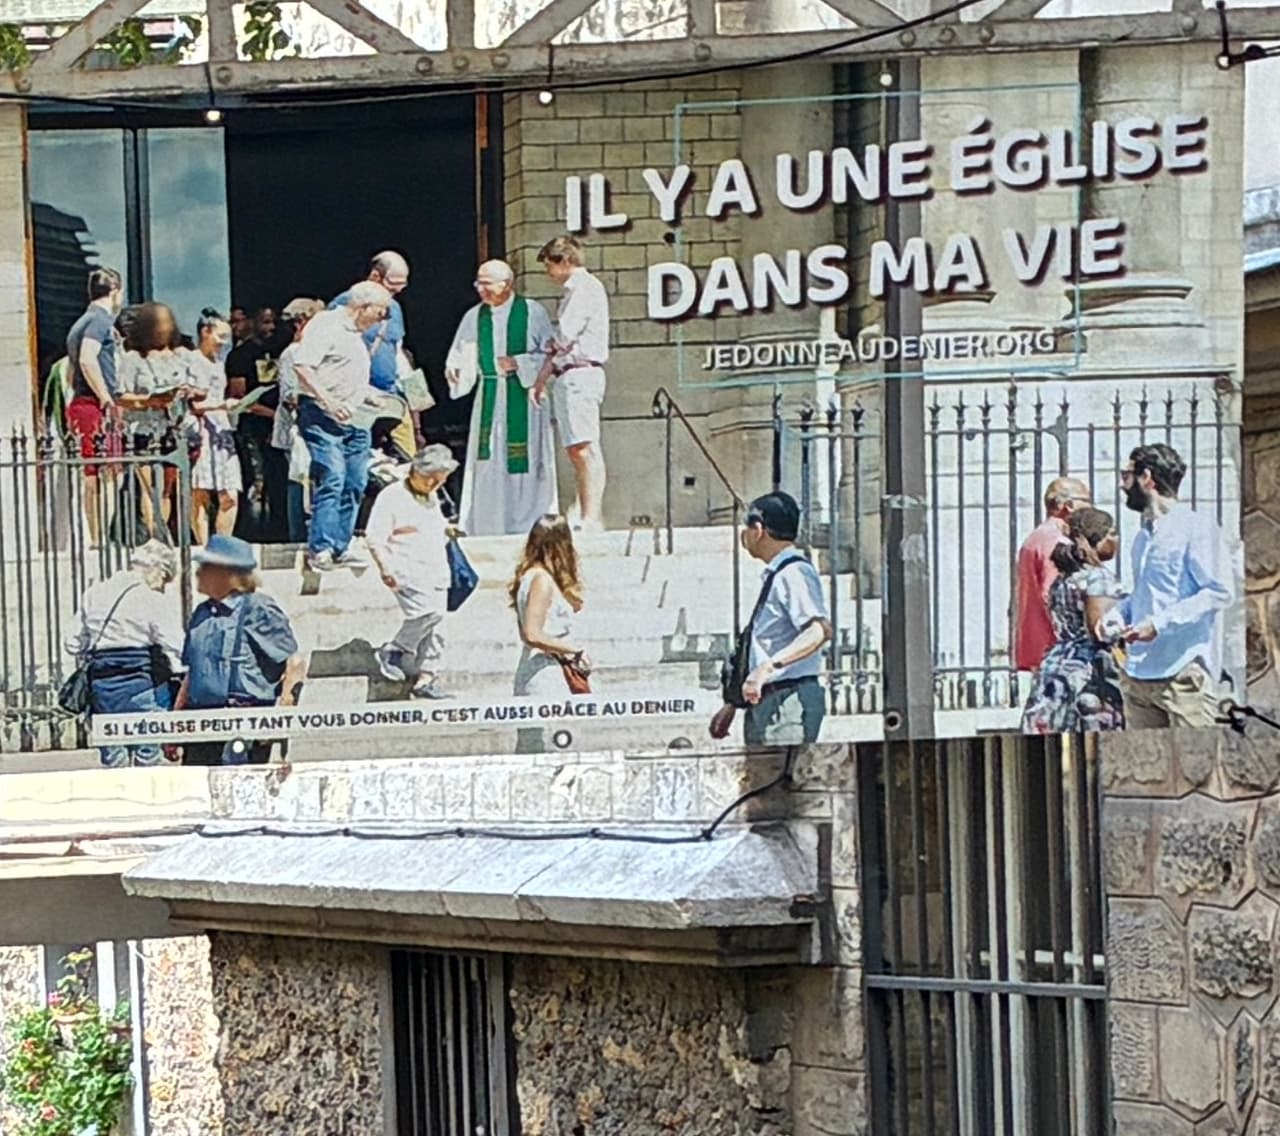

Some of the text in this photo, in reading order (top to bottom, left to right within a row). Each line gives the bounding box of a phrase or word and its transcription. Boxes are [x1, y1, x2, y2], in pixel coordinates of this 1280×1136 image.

[565, 113, 1208, 234] IL Y A UNE ÉGLISE
[646, 217, 1126, 321] DANS MA VIE
[700, 329, 1056, 372] JEDONNEAUDENIER.ORG
[103, 698, 695, 737] SI L'ÉGLISE PEUT TANT VOUS DONNER, C'EST AUSSI GRÂCE AU DENIER
